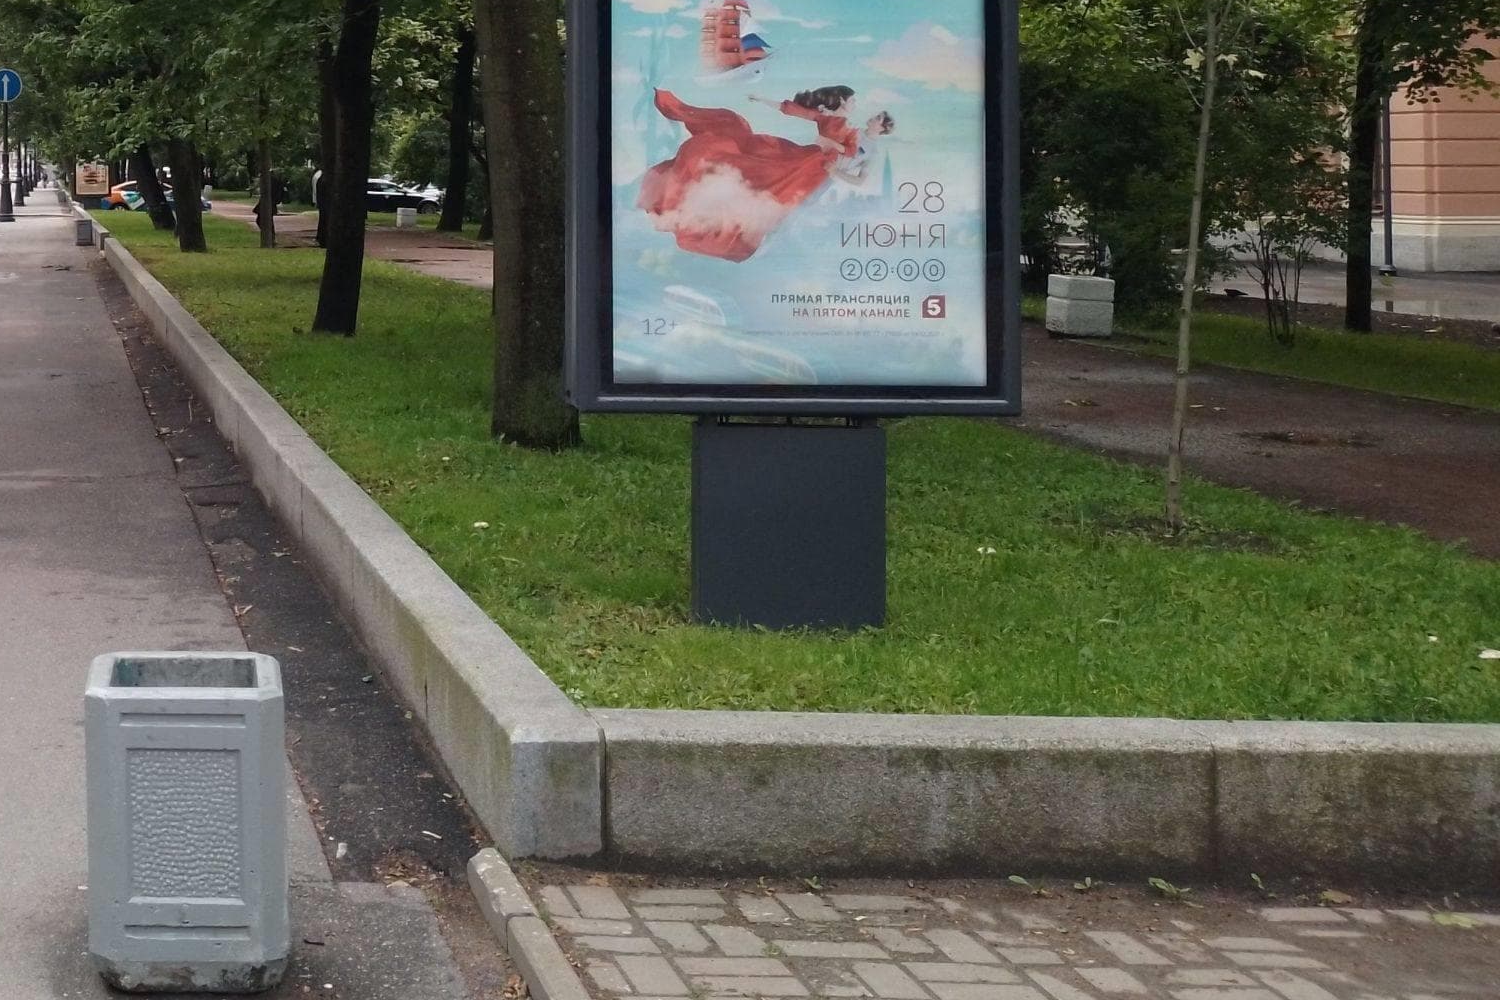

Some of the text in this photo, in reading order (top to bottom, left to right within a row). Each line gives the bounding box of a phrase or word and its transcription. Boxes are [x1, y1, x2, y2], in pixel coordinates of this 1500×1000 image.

[897, 181, 945, 214] 28
[841, 223, 946, 249] ИЮНЯ
[840, 258, 946, 282] 22:00
[771, 294, 910, 305] ПРЯМАЯ ТРАНСЛЯЦИЯ
[792, 307, 911, 318] НА ПЯТОМ КАНАЛЕ
[642, 318, 678, 336] 12+
